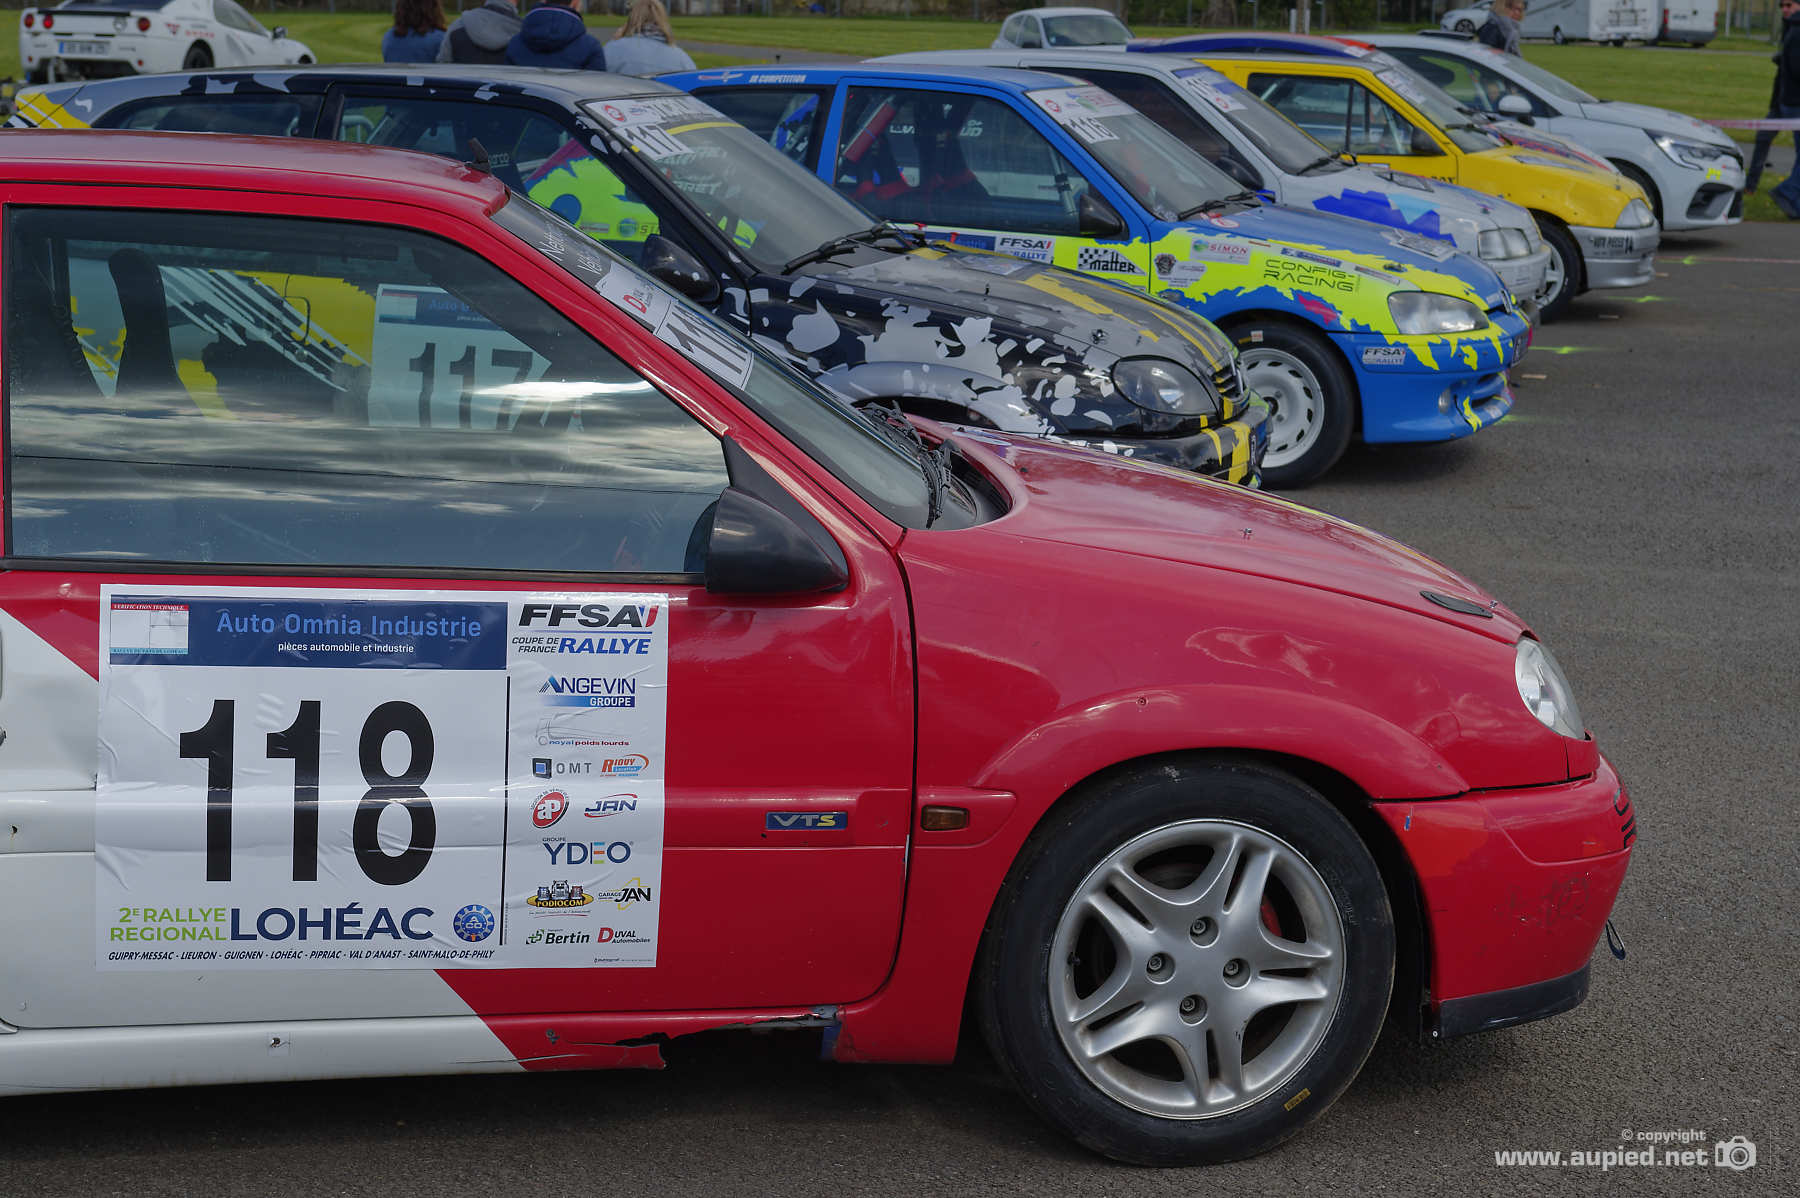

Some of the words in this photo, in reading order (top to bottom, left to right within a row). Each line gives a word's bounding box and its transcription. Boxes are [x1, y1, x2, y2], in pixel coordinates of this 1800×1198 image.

[1070, 117, 1113, 139] 116
[624, 125, 684, 155] 117
[1000, 237, 1045, 249] FFSA
[1209, 243, 1248, 254] SIMON
[1266, 260, 1354, 279] CONFIG-
[1264, 270, 1353, 292] RACING
[409, 343, 533, 431] 117
[519, 604, 643, 627] FFSA
[217, 612, 276, 633] Auto
[285, 613, 362, 635] Omnia
[371, 615, 482, 637] Industrie
[278, 642, 308, 653] pièces
[309, 642, 361, 653] automobile
[362, 643, 373, 653] et
[374, 642, 415, 654] industrie
[512, 637, 544, 645] COUPE
[546, 637, 560, 645] DE
[518, 645, 557, 653] FRANCE
[558, 637, 651, 655] RALLYE
[539, 675, 636, 694] ANGEVIN
[589, 697, 631, 706] GROUPE
[180, 699, 437, 886] 118
[585, 800, 638, 812] JAN
[774, 814, 836, 827] VTS
[537, 899, 583, 907] PODIOCOM
[616, 887, 651, 903] JAN
[143, 907, 227, 923] RALLYE
[230, 902, 434, 941] LOHÉAC
[110, 926, 227, 942] REGIONAL
[545, 931, 590, 944] Bertin
[598, 927, 637, 943] DUVAL
[108, 951, 174, 961] GUIPRY-MESSAC
[180, 951, 218, 961] LIEURON
[223, 950, 264, 960] GUIGNEN
[270, 949, 303, 960] LOHÉAC
[309, 950, 342, 960] PIPRIAC
[349, 950, 365, 960] VAL
[407, 950, 495, 960] SAINT-MALO-DE-PHILY
